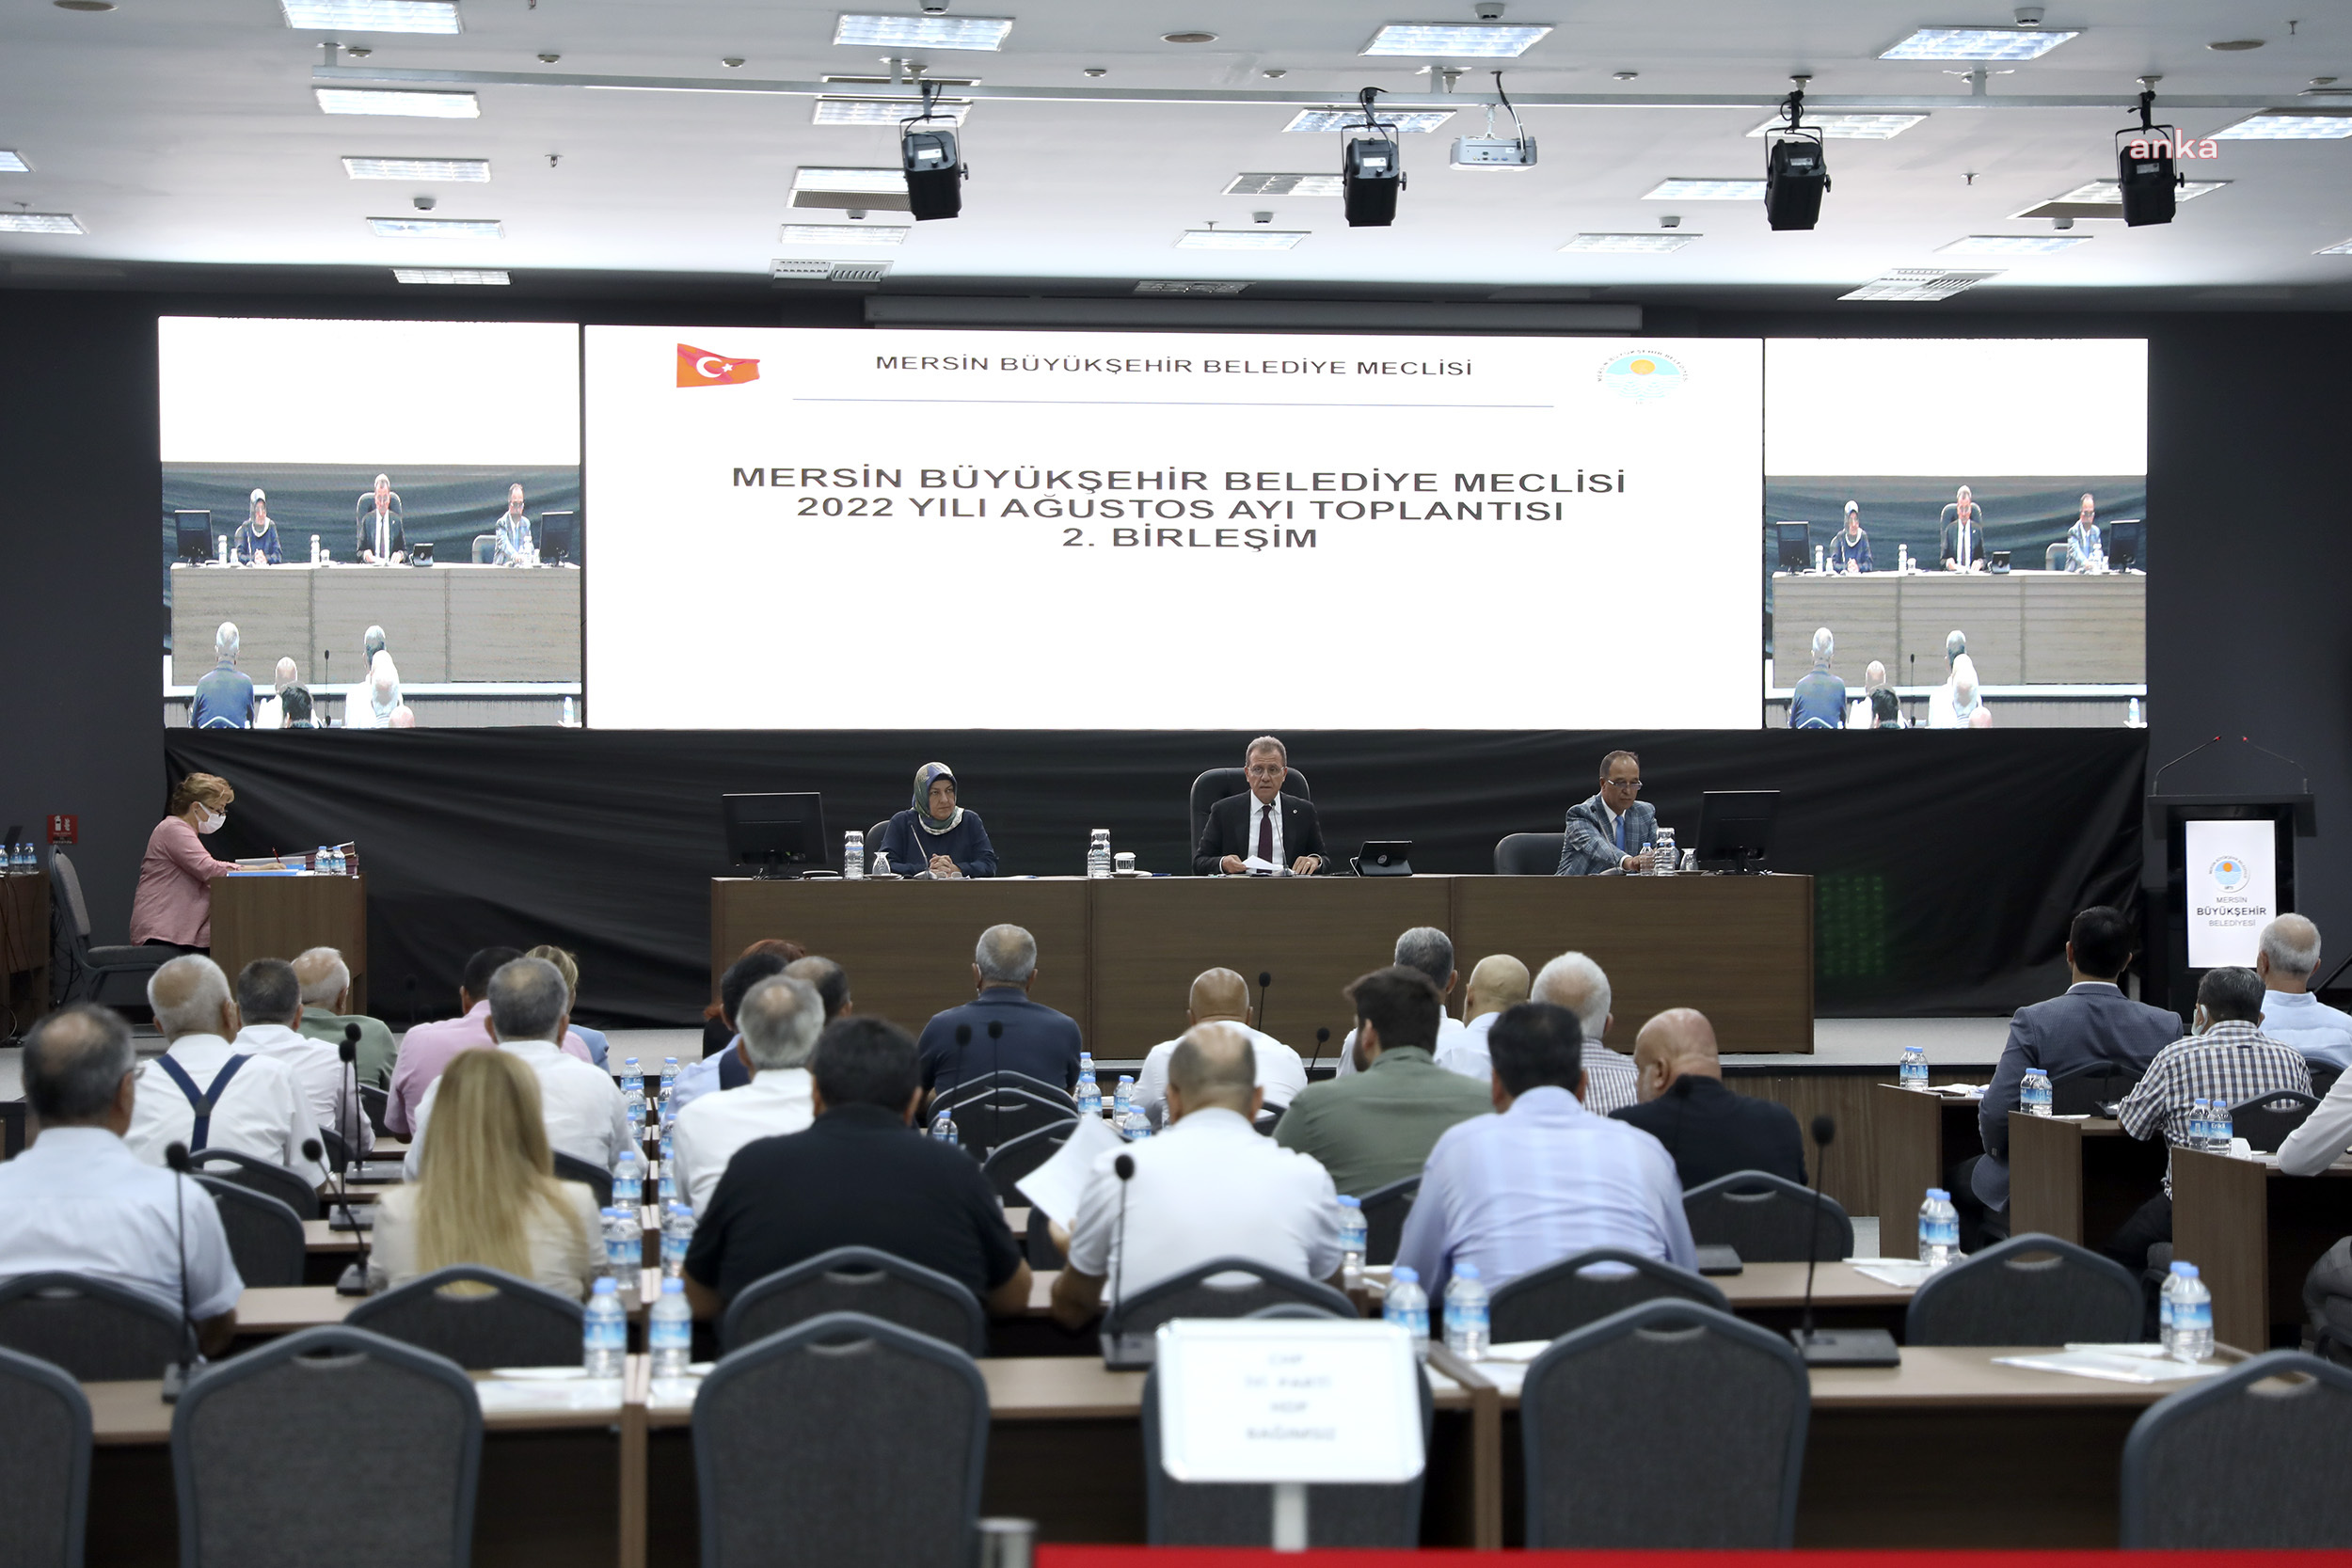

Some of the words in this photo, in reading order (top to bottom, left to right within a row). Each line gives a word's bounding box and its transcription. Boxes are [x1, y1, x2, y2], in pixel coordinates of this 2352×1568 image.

[876, 354, 988, 371] MERSİN
[1000, 354, 1192, 375] BÜYÜKŞEHİR
[1203, 357, 1346, 374] BELEDİYE
[1357, 358, 1471, 376] MECLİSİ
[733, 463, 902, 488] MERSİN
[920, 465, 1208, 495] BÜYÜKŞEHİR
[1225, 467, 1438, 492] BELEDİYE
[1454, 468, 1625, 494] MECLİSİ
[797, 497, 893, 517] 2022
[908, 498, 986, 517] YILI
[1000, 493, 1215, 520] AĞUSTOS
[1228, 499, 1294, 520] AYI
[1309, 500, 1563, 521] TOPLANTISI
[1062, 527, 1095, 547] 2.
[1113, 522, 1316, 552] BİRLEŞİM
[2196, 906, 2267, 916] BÜYÜKŞEHİR
[2208, 918, 2256, 927] BELEDİYESİ
